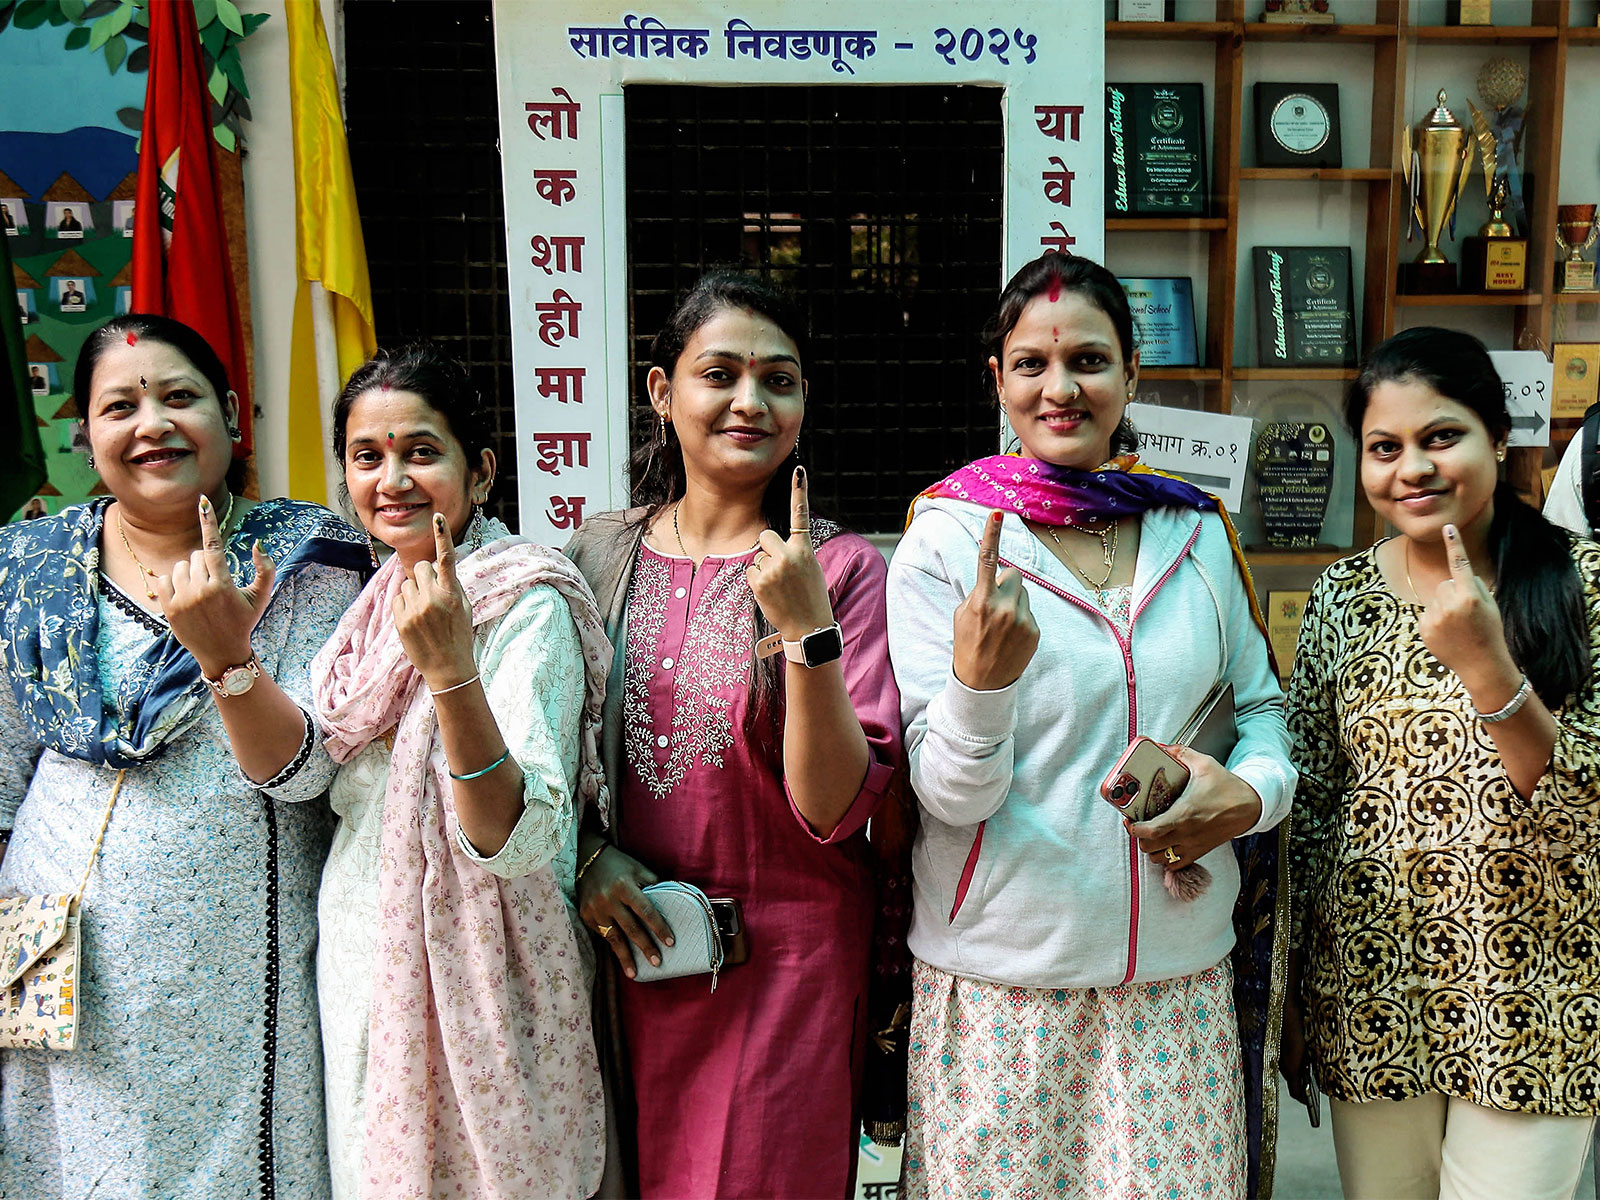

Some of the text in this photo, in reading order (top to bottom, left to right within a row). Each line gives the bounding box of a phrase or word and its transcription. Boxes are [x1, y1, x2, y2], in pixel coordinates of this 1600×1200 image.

[567, 14, 710, 58] सार्वत्रिक
[724, 18, 878, 75] निवडणूक
[934, 27, 1038, 65] २०२५
[1150, 137, 1185, 145] Certificate
[1147, 303, 1172, 314] School
[1138, 431, 1184, 454] प्रभाग
